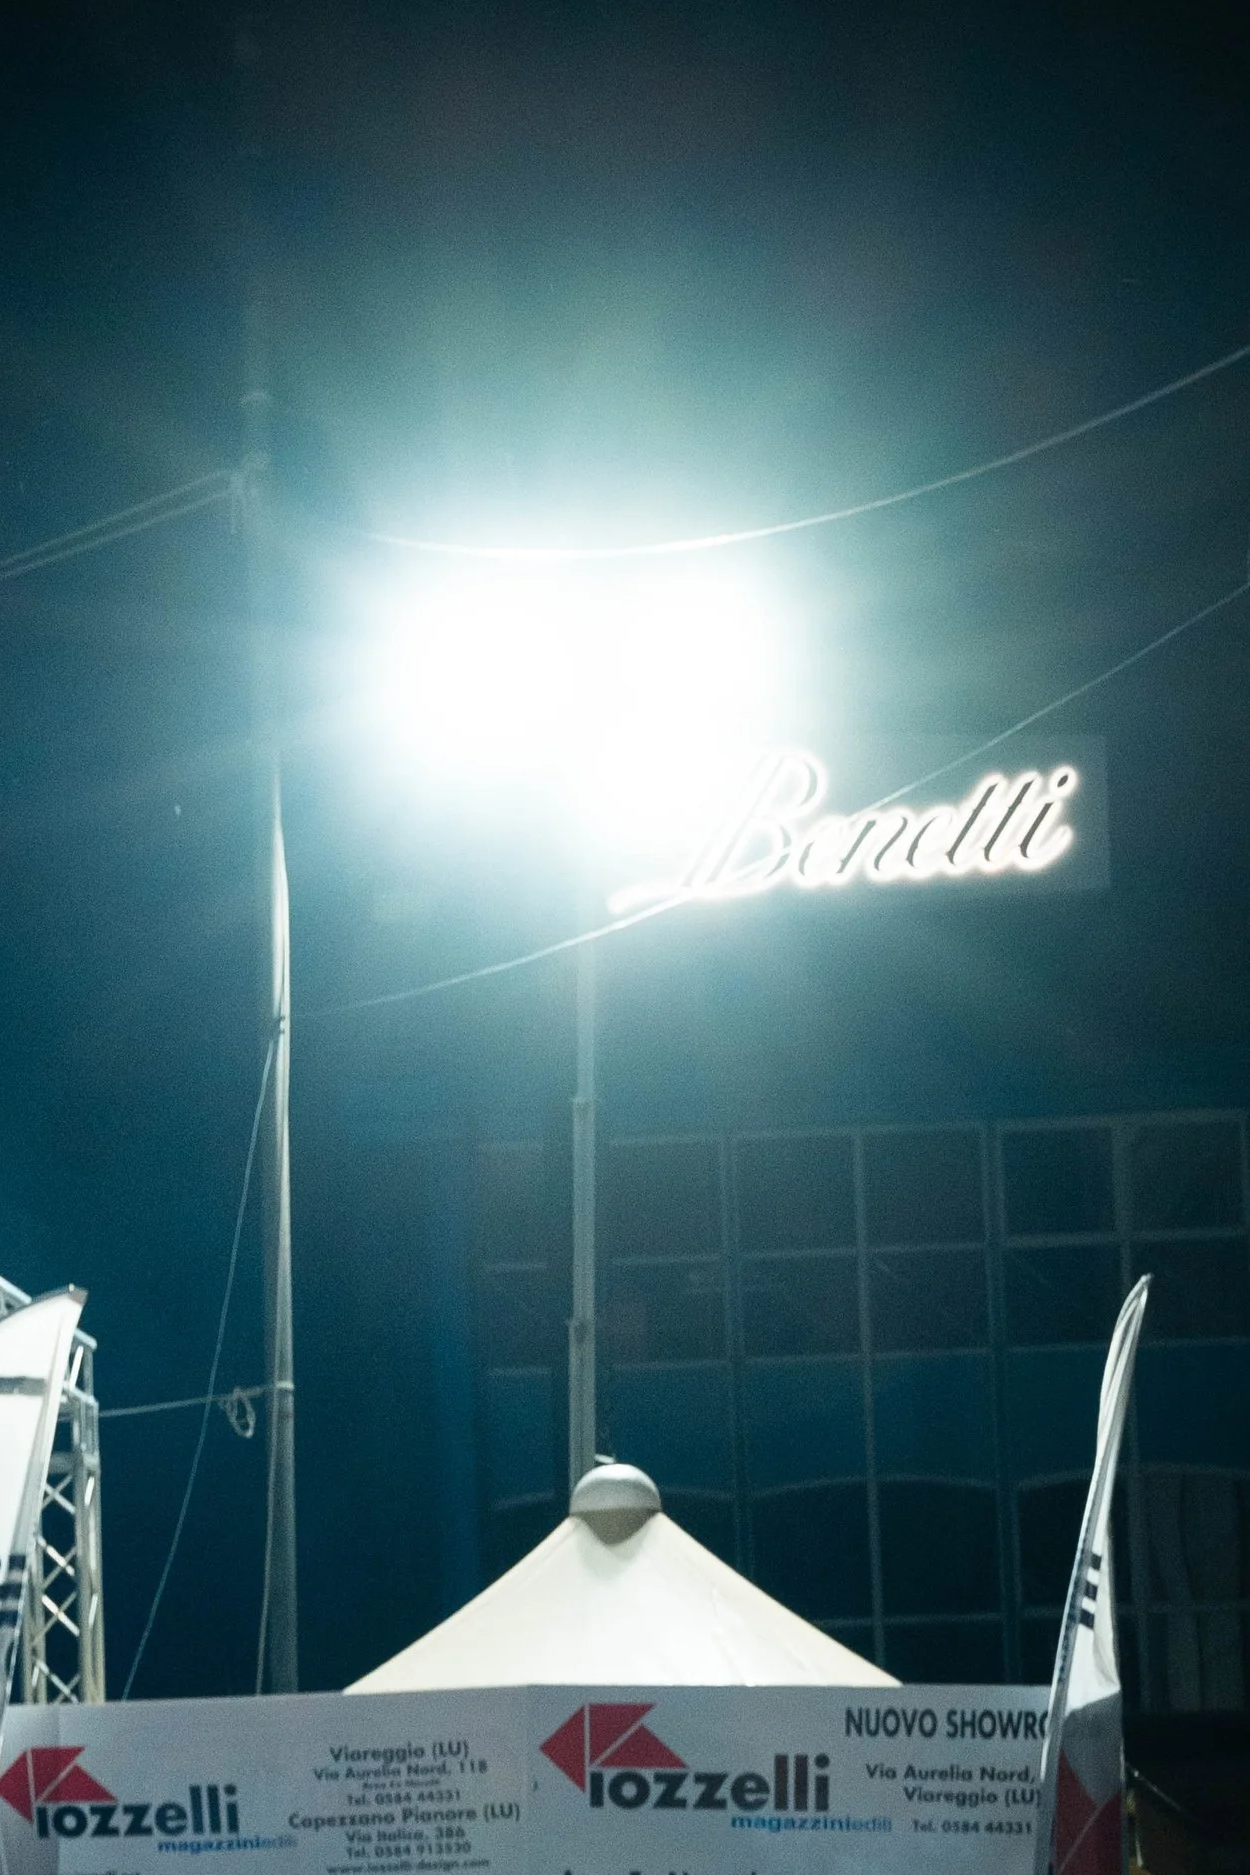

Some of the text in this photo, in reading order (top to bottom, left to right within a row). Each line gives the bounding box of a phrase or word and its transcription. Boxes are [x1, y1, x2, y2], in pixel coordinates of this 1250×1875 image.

[607, 748, 1078, 913] Benelli
[845, 1708, 938, 1739] NUOVO
[330, 1740, 470, 1765] Viareggio (LU)
[314, 1768, 340, 1781] Via
[345, 1763, 402, 1780] Aurelia
[589, 1752, 831, 1813] iozzelli
[865, 1763, 1036, 1785] Via Aurelia Nord,
[36, 1783, 240, 1839] iozzelli
[902, 1785, 1043, 1810] Viareggio (LU)
[288, 1801, 521, 1833] Capezzano Pianore (LU)
[941, 1818, 981, 1835] 0584
[984, 1819, 1033, 1836] 44331
